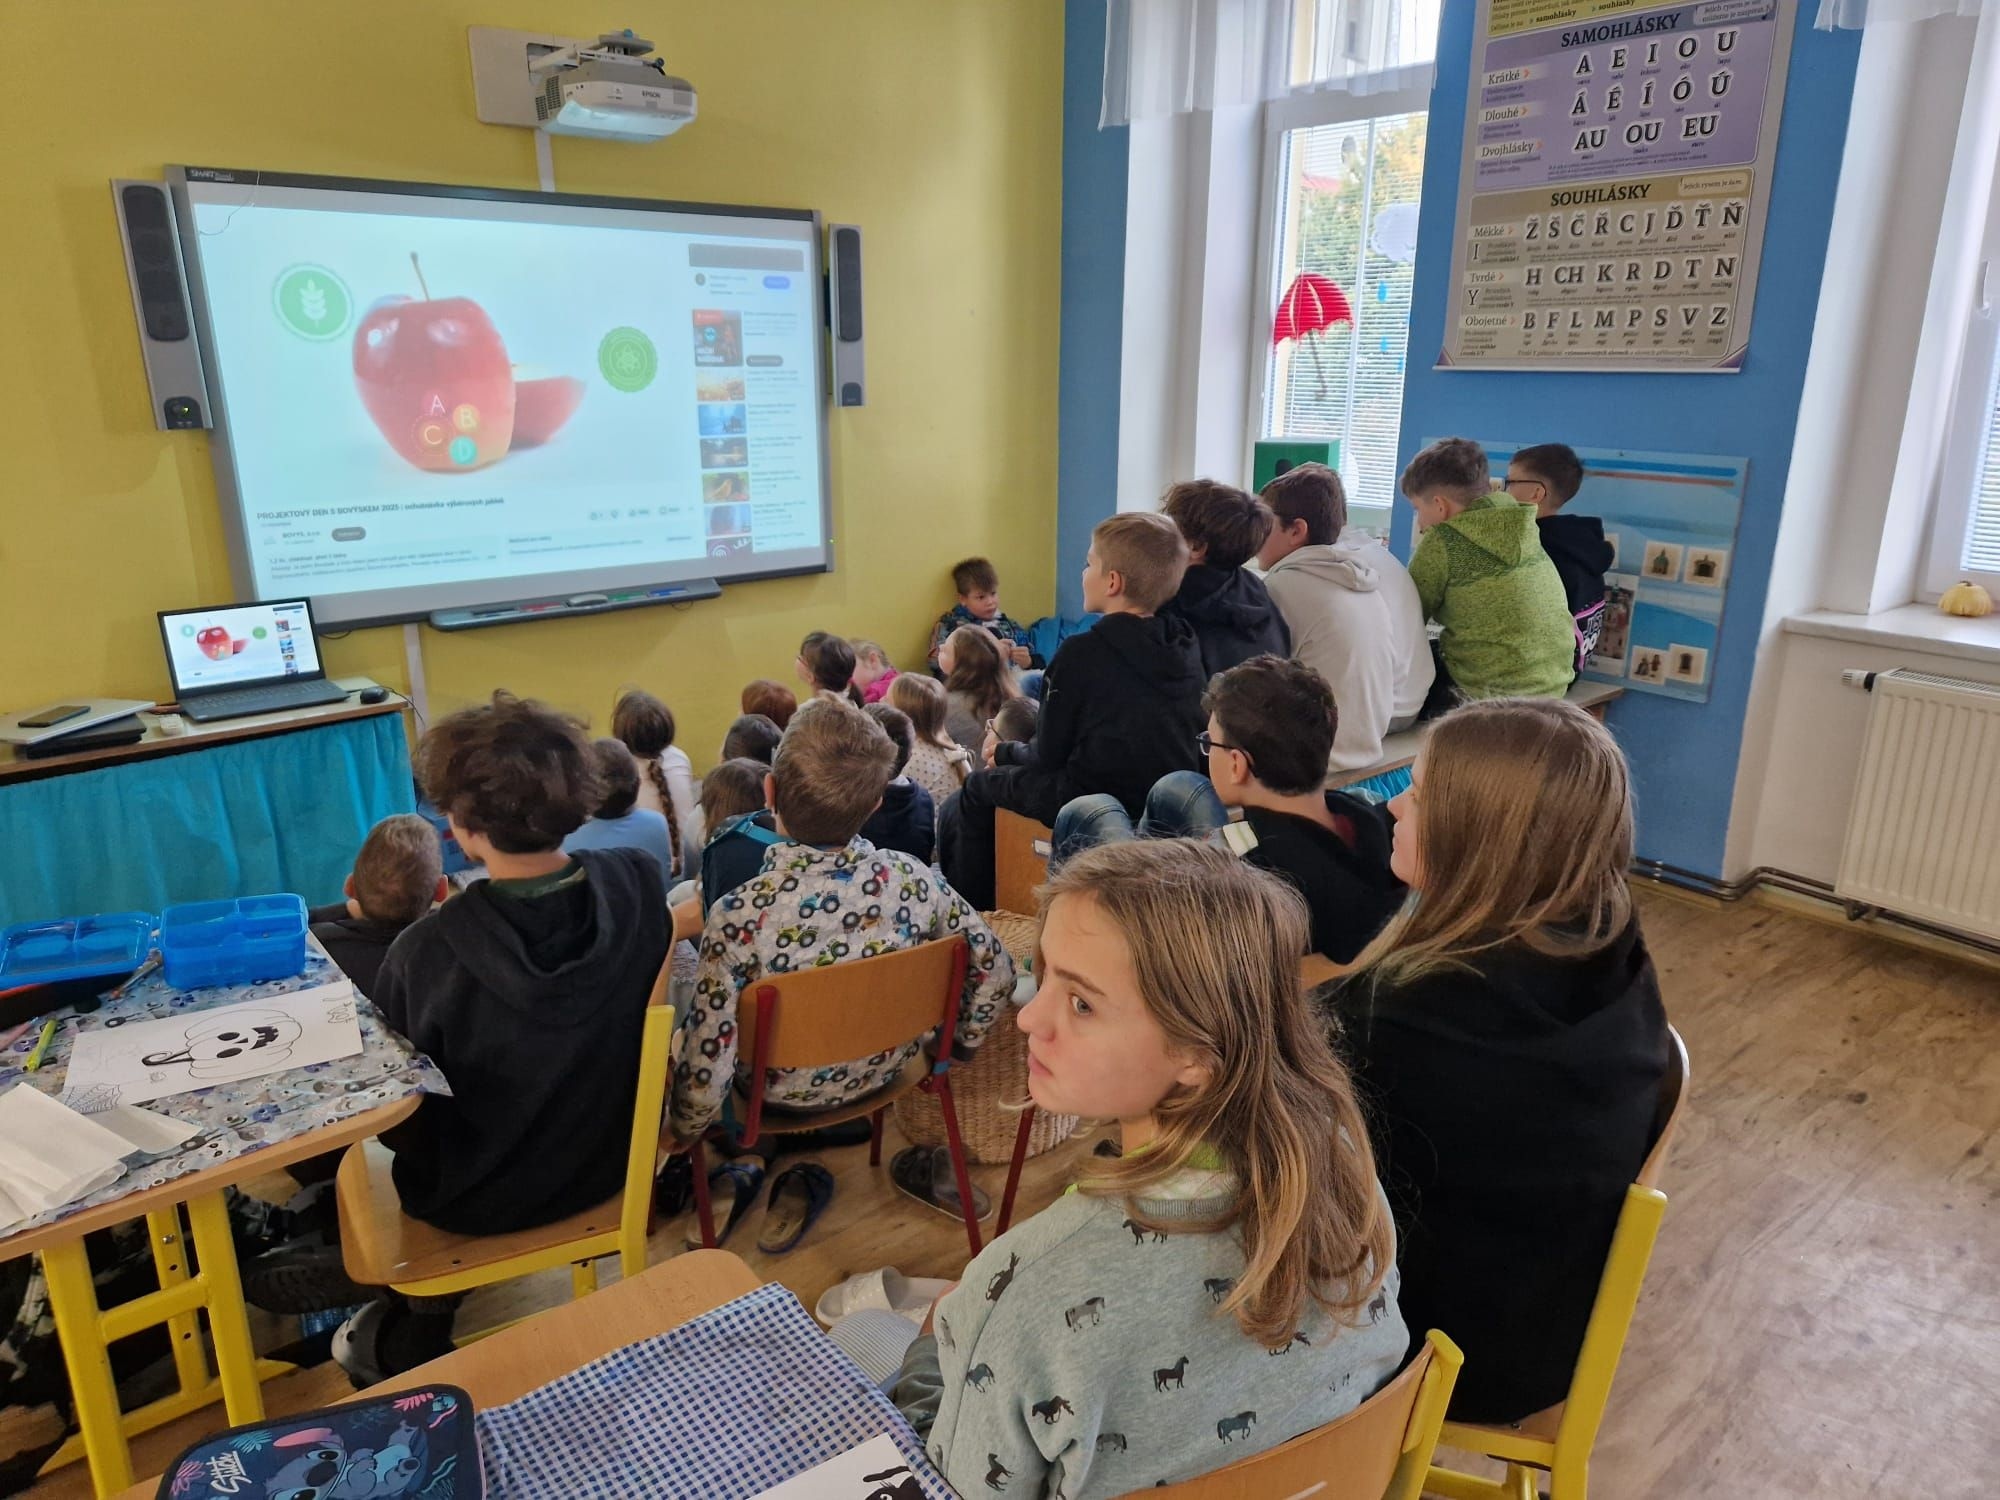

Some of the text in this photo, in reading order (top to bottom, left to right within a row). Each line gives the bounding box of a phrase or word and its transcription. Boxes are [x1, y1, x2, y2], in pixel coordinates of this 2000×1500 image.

[1536, 9, 1577, 23] samohlásky
[1561, 13, 1680, 48] SAMOHLÁSKY
[1576, 31, 1737, 74] A E I O U
[1488, 70, 1520, 85] Krátké
[1572, 71, 1731, 115] Á É Í Ó Ú
[1485, 107, 1519, 121] Dlouhé
[1574, 115, 1719, 151] AU OU EU
[1481, 141, 1534, 158] Dvojhlásky
[1550, 184, 1652, 207] SOUHLÁSKY
[1526, 201, 1745, 240] Ž Š Č Ř C J Ď Ť Ň
[1471, 271, 1496, 283] Tvrdé
[1525, 257, 1737, 286] H CH K R D T N
[1468, 289, 1479, 306] Y
[1465, 315, 1507, 328] Obojetné
[1523, 307, 1727, 329] B F L M P S V Z
[431, 394, 446, 415] A
[460, 407, 477, 430] B
[424, 425, 443, 445] C
[206, 1450, 252, 1493] Stitch
